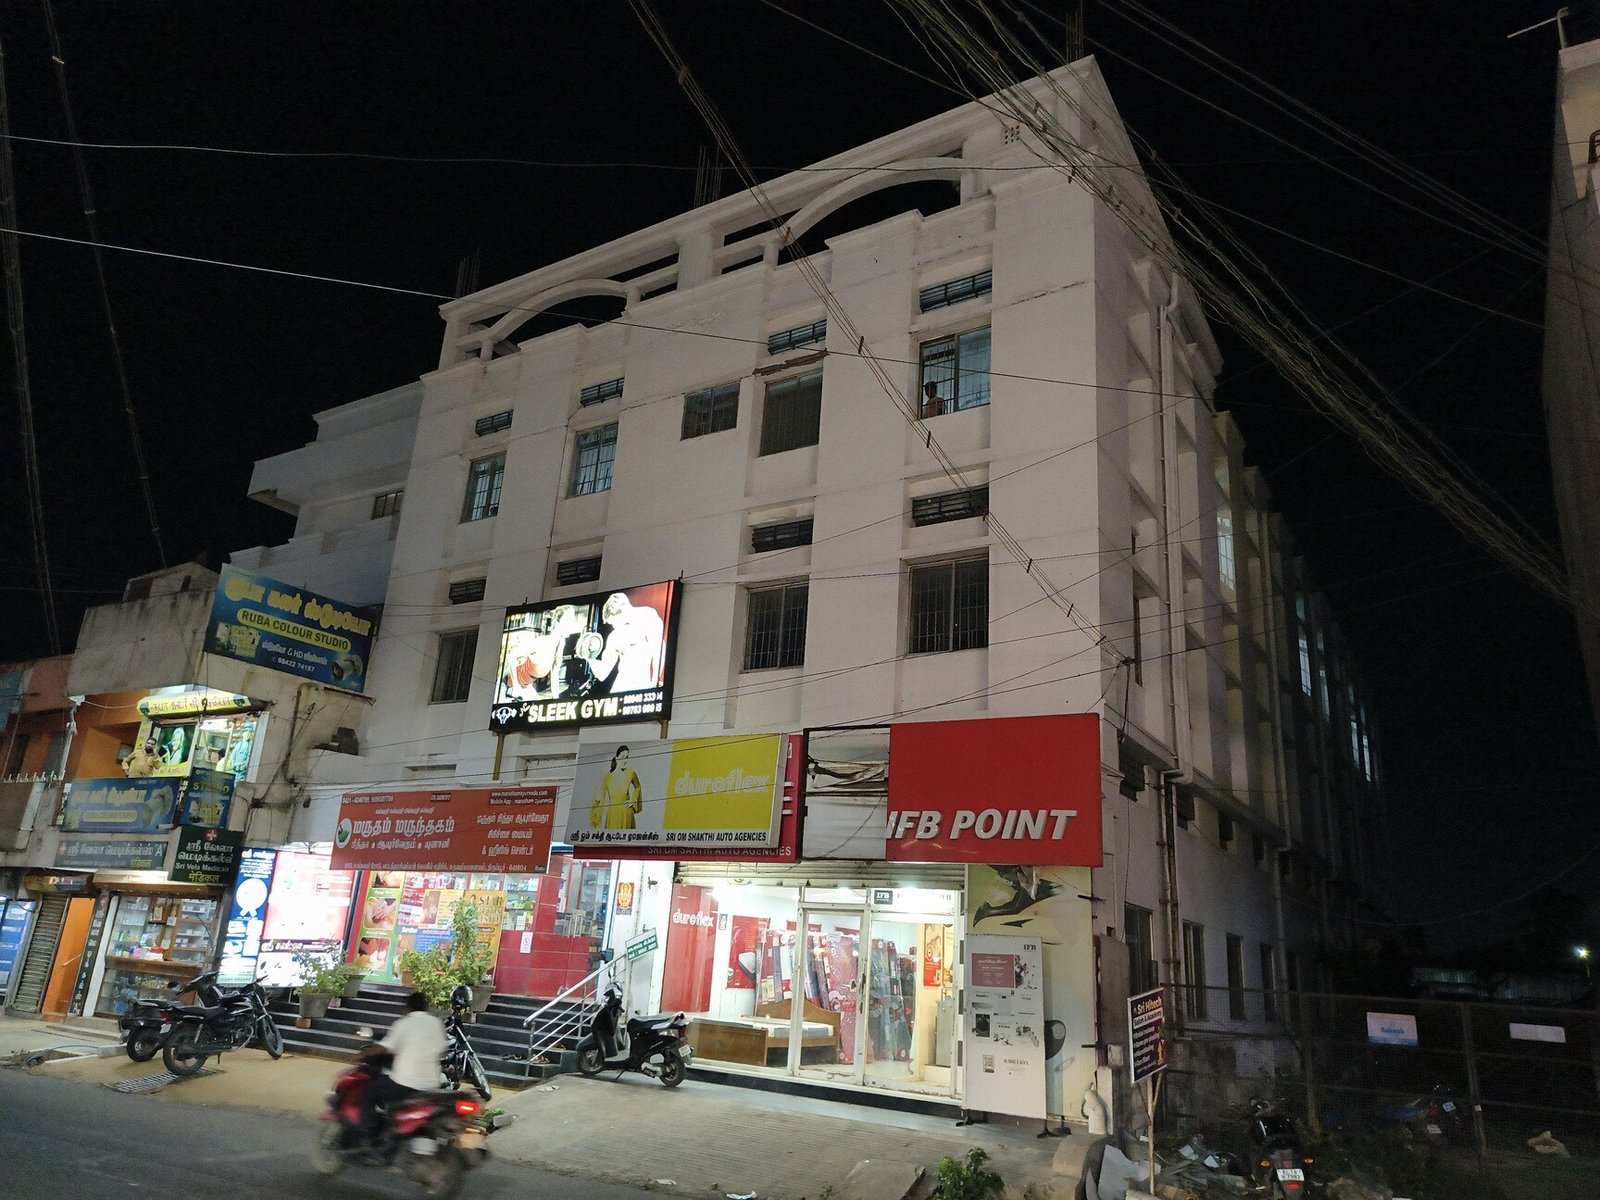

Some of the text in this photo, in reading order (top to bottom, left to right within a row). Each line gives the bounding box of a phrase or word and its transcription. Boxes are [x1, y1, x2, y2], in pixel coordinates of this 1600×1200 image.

[241, 610, 349, 650] RUBA COLOUR STUDIO
[293, 648, 304, 659] HD
[527, 702, 578, 723] SLEEK
[580, 697, 619, 718] GYM
[675, 767, 769, 795] duroflex
[353, 816, 455, 837] மருதம் மருந்தகம்
[886, 809, 1078, 841] IFB POINT
[666, 832, 767, 842] SRI OM SHAKTHI AUTO AGENCIES
[741, 845, 792, 857] AGENCIES
[672, 908, 714, 928] duroflex
[1137, 1001, 1145, 1015] Sri
